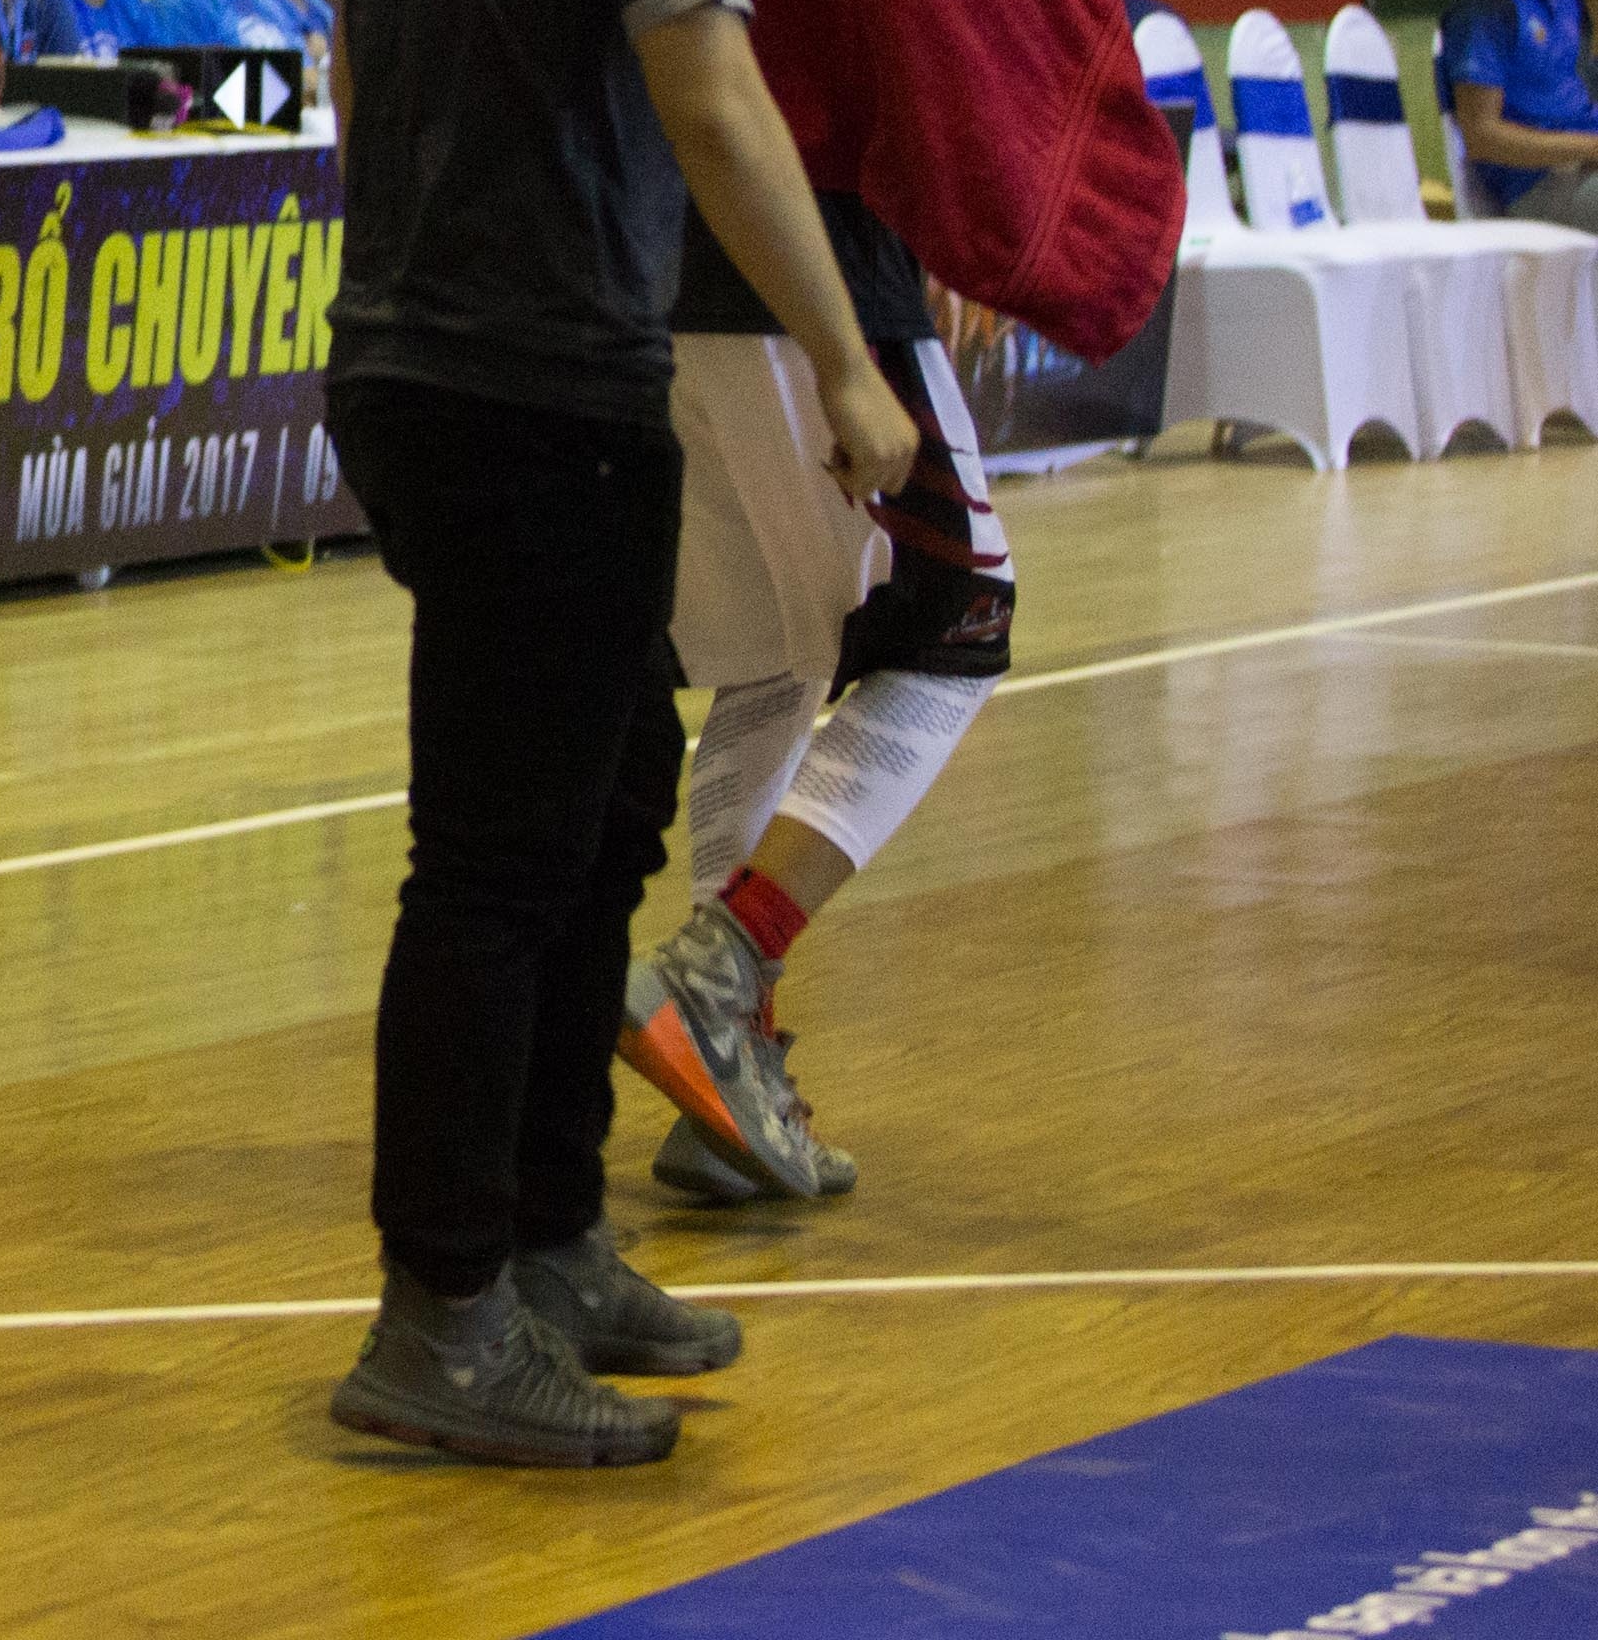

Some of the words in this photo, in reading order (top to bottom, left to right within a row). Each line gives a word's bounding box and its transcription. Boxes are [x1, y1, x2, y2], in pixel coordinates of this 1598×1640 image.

[85, 191, 345, 397] CHUYÊN
[16, 433, 89, 544] MÙA
[179, 427, 261, 521] 2017
